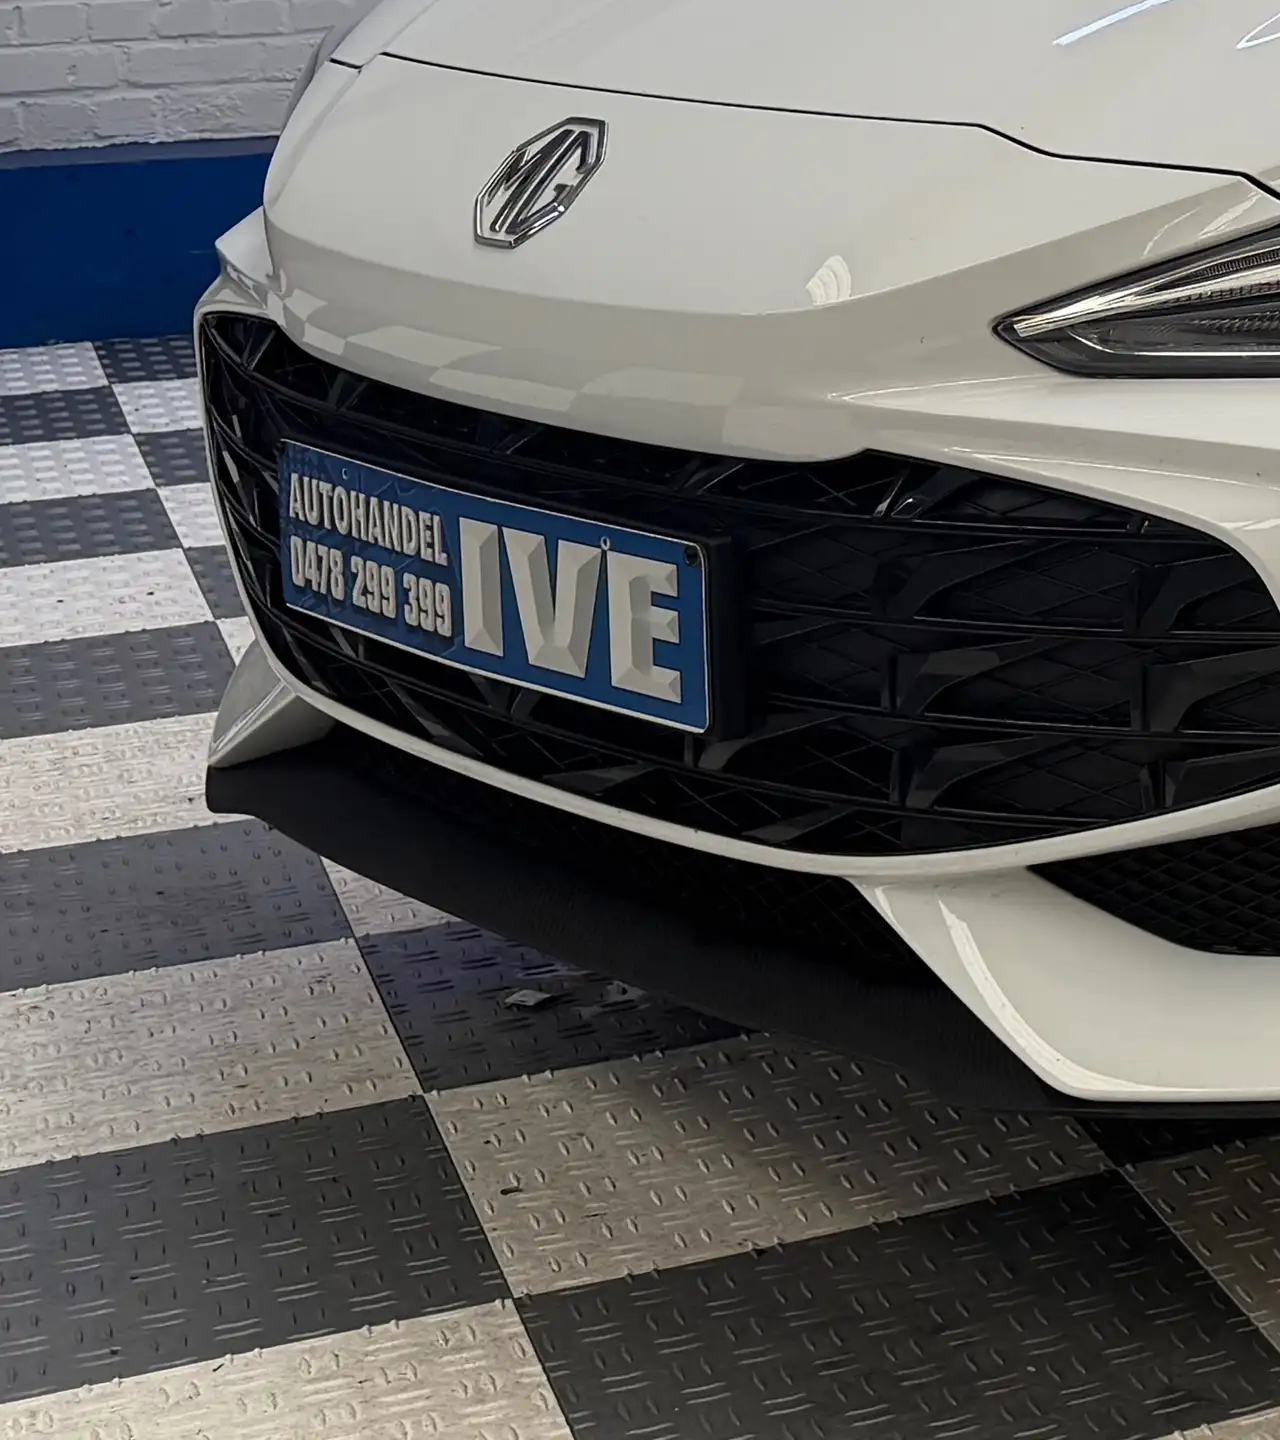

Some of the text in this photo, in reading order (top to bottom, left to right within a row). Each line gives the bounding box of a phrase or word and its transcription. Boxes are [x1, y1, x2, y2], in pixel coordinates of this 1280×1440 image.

[477, 120, 604, 247] MG
[289, 471, 449, 567] AUTOHANDEL
[290, 534, 453, 638] 0478 299 399
[458, 515, 684, 705] IVE
